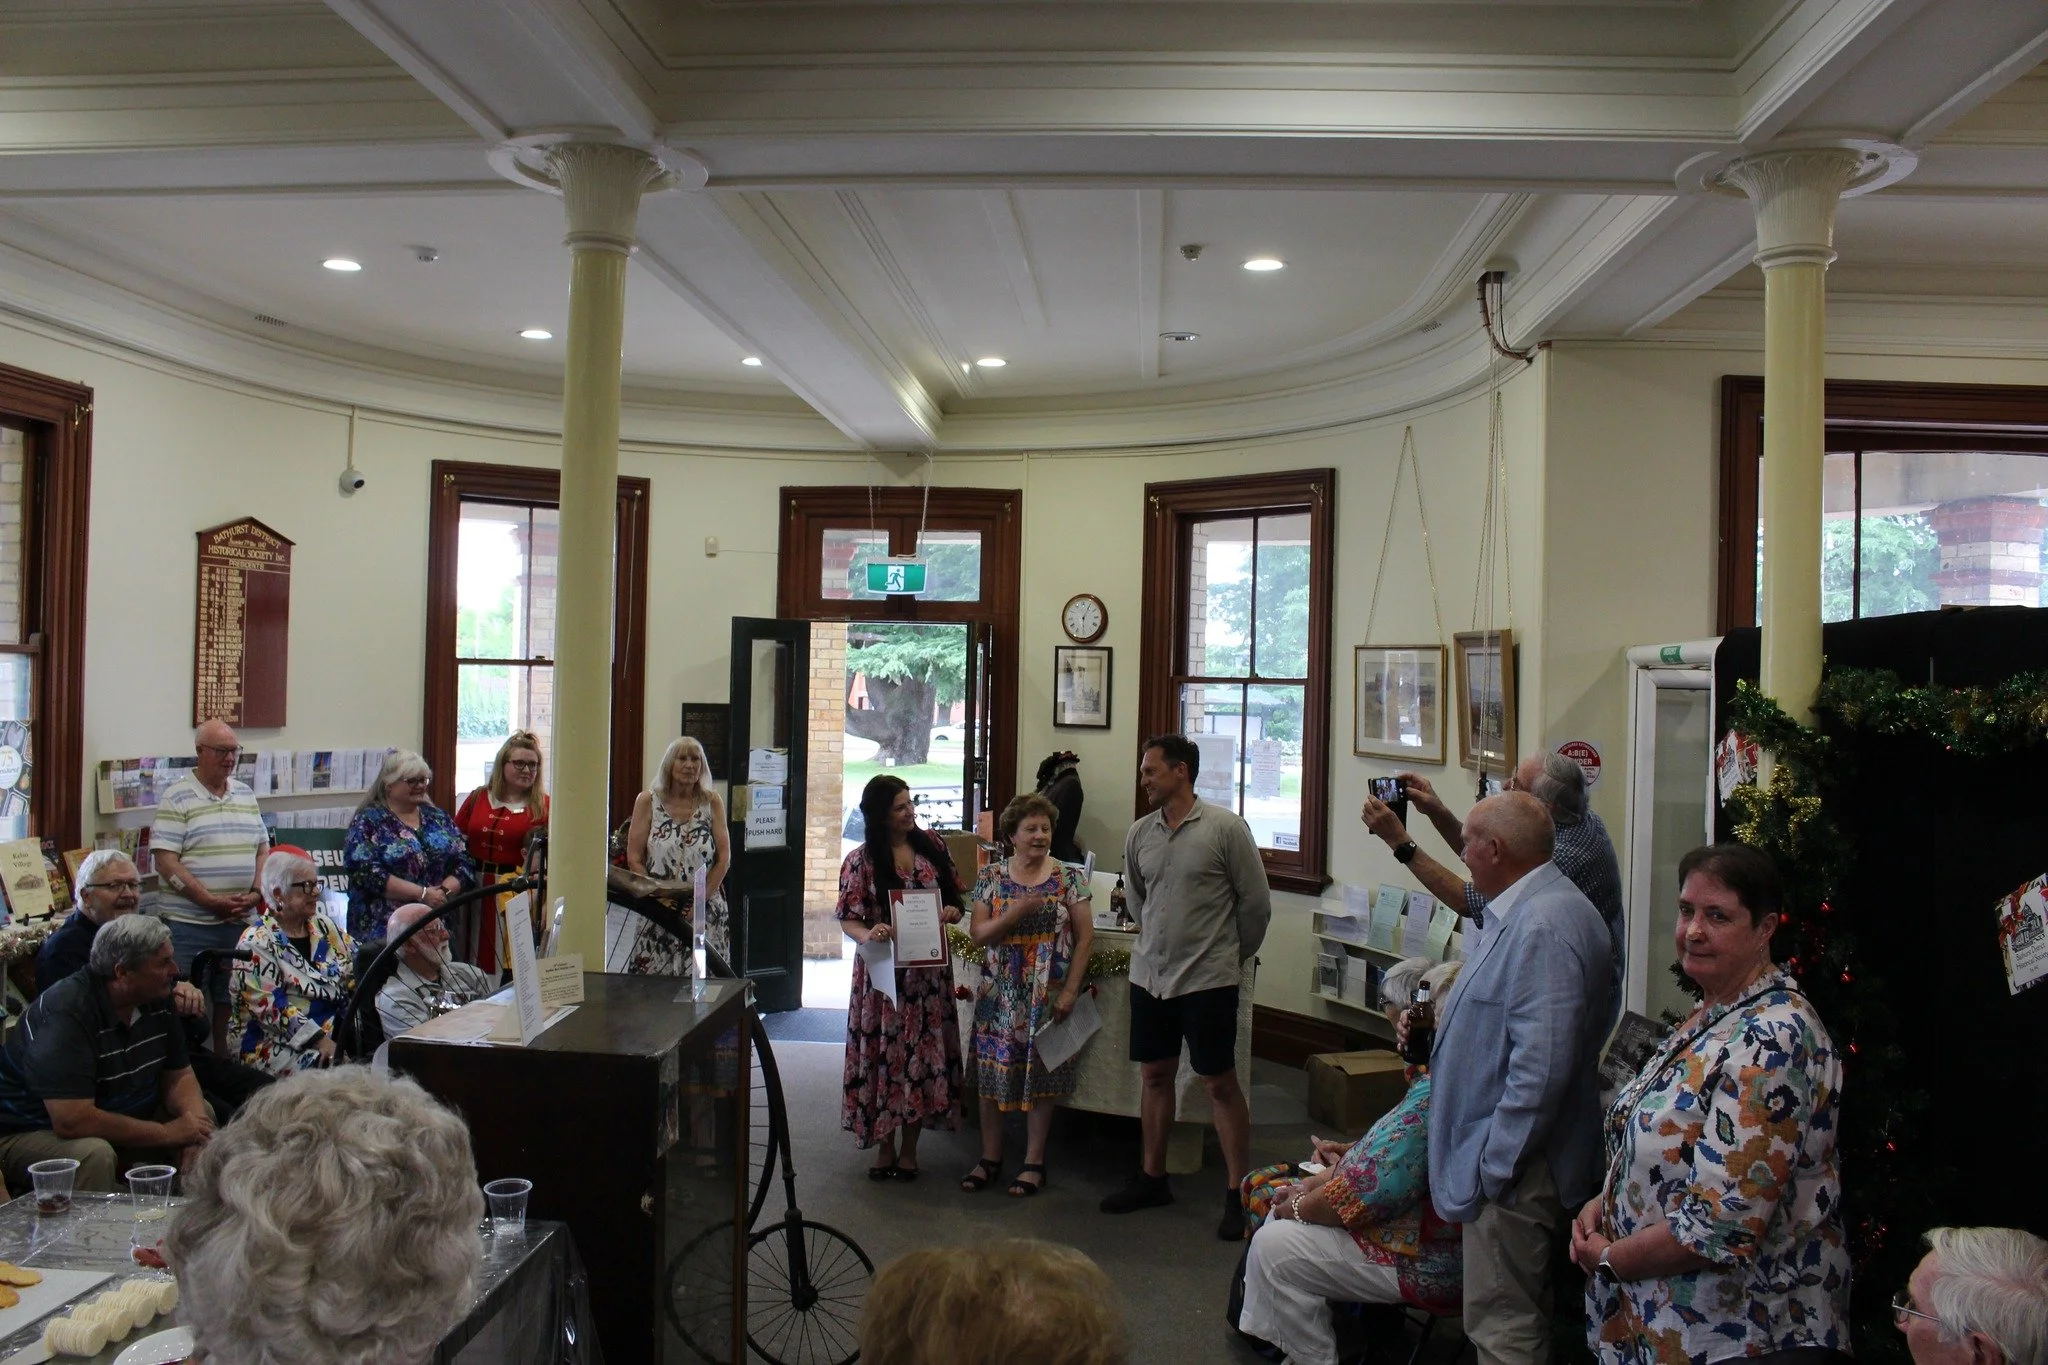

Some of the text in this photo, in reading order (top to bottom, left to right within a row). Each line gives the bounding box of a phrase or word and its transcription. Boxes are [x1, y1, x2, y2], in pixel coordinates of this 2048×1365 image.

[213, 524, 249, 543] BATHURST
[250, 525, 282, 549] DISTRICT
[208, 544, 246, 558] HISTORICAL
[247, 549, 274, 561] SOCIETY
[311, 849, 344, 867] SEU
